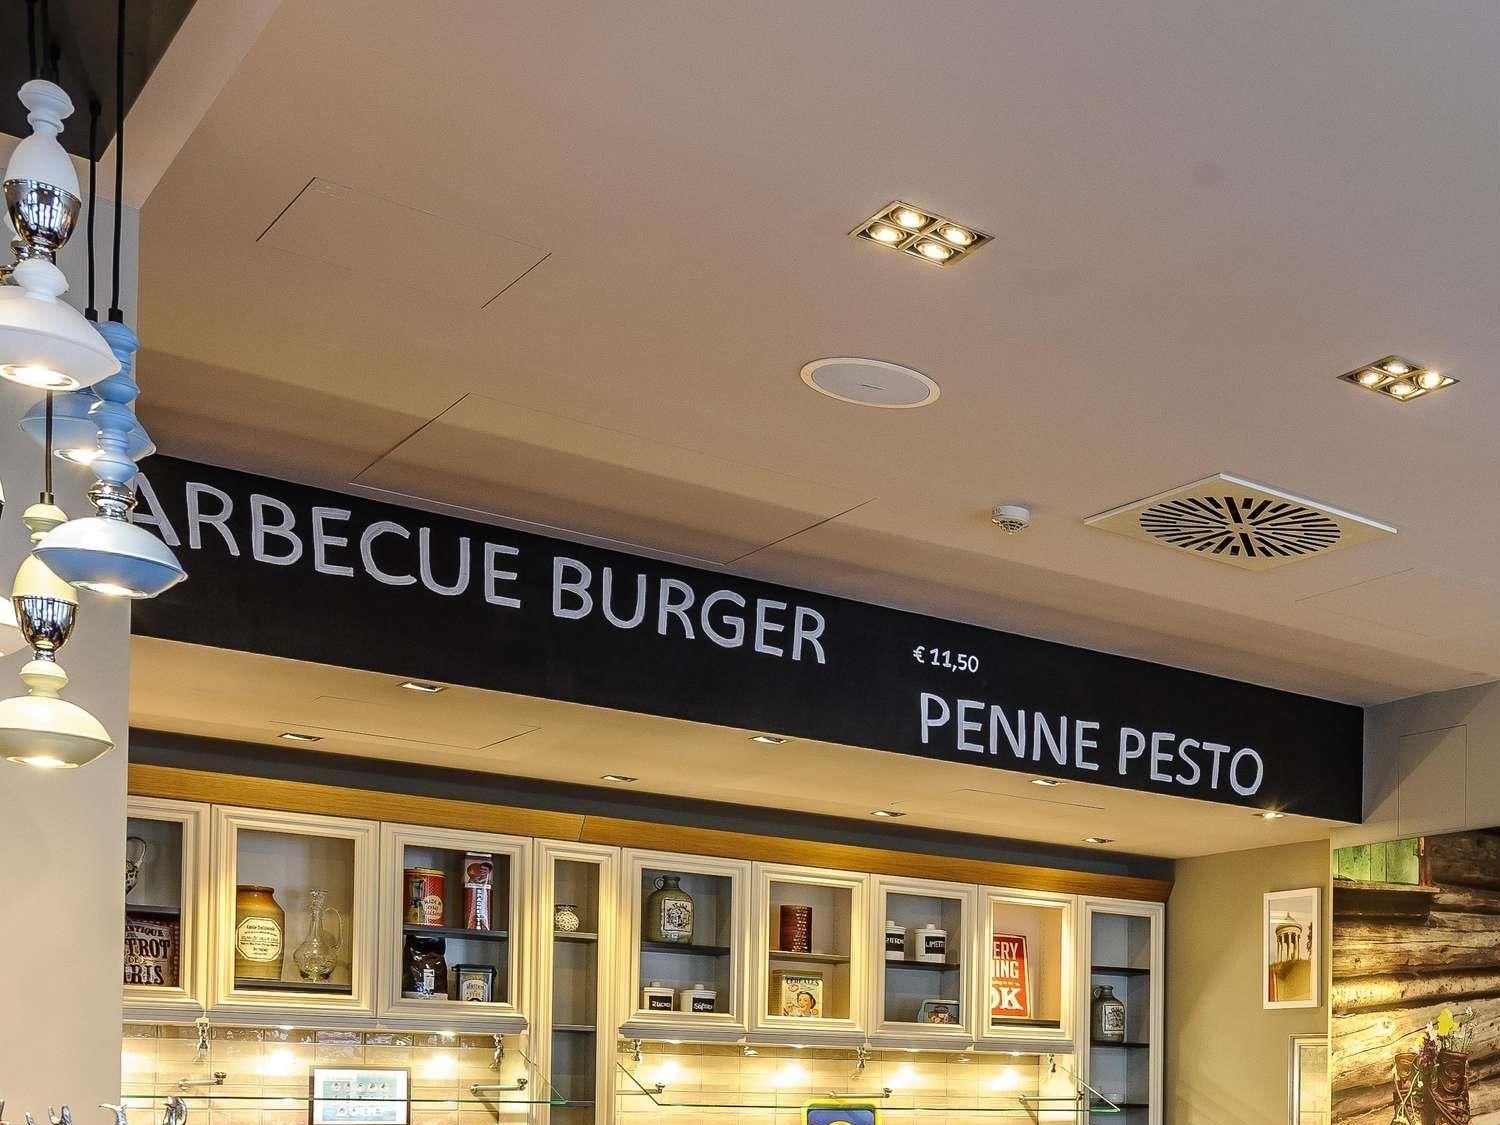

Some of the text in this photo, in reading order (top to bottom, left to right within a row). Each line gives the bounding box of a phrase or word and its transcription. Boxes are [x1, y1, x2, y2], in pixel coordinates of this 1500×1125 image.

[552, 556, 826, 664] BURGER
[929, 648, 980, 673] 11,50
[920, 692, 1264, 796] PENNE PESTO
[993, 941, 1019, 960] ERY
